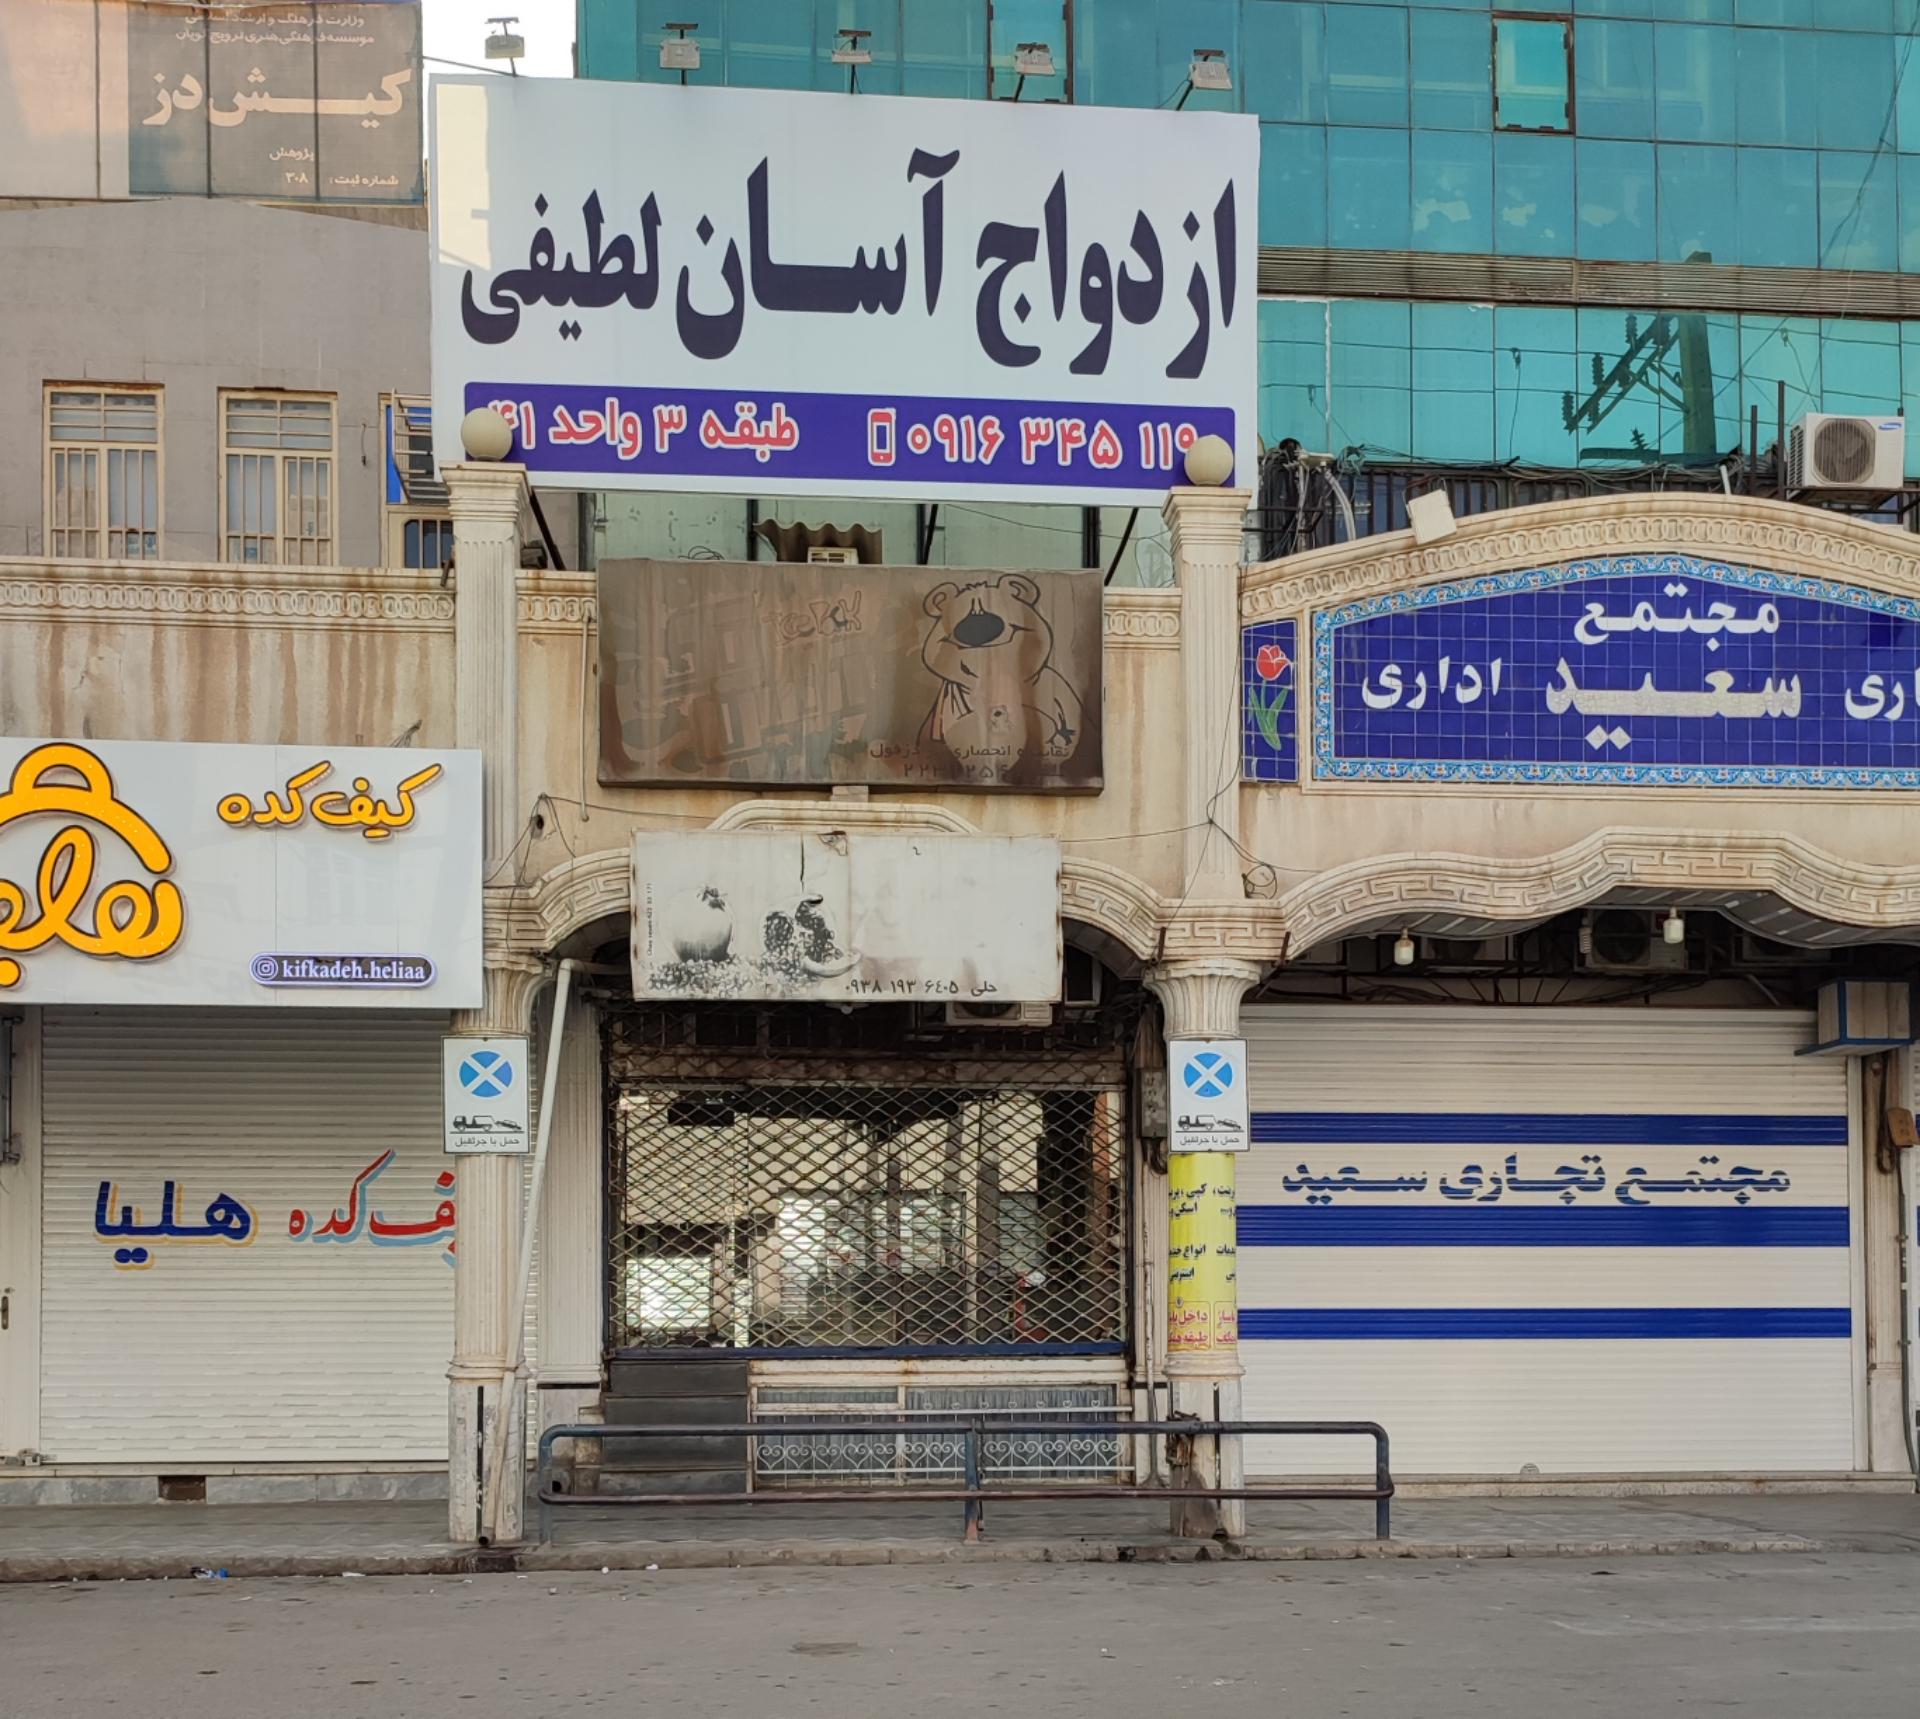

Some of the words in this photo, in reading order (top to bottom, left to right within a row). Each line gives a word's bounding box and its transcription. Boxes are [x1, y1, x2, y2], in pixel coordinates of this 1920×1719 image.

[143, 70, 203, 126] دز
[208, 67, 412, 128] کیش
[460, 188, 661, 345] لطیفی
[676, 147, 960, 360] آسان
[975, 169, 1236, 379] ازدواج
[548, 396, 643, 461] واحد
[653, 404, 688, 453] ۳
[700, 401, 800, 463] طبقه
[906, 412, 1004, 466] ۰۹۱۶
[1020, 416, 1123, 470] ۳۴۵
[1574, 582, 1780, 651] مجتمع
[1361, 655, 1502, 711] اداری
[1545, 656, 1802, 751] سعید
[282, 959, 426, 980] kifkadeh.heliaa
[890, 978, 916, 994] ۱۹۳
[454, 1135, 488, 1148] جرثقیل
[499, 1136, 521, 1148] حمل
[1220, 1136, 1240, 1146] حمل
[1281, 1160, 1428, 1205] سعید
[1438, 1151, 1607, 1205] تجاری
[1615, 1155, 1792, 1205] مجتمع
[94, 1180, 255, 1267] هلیا
